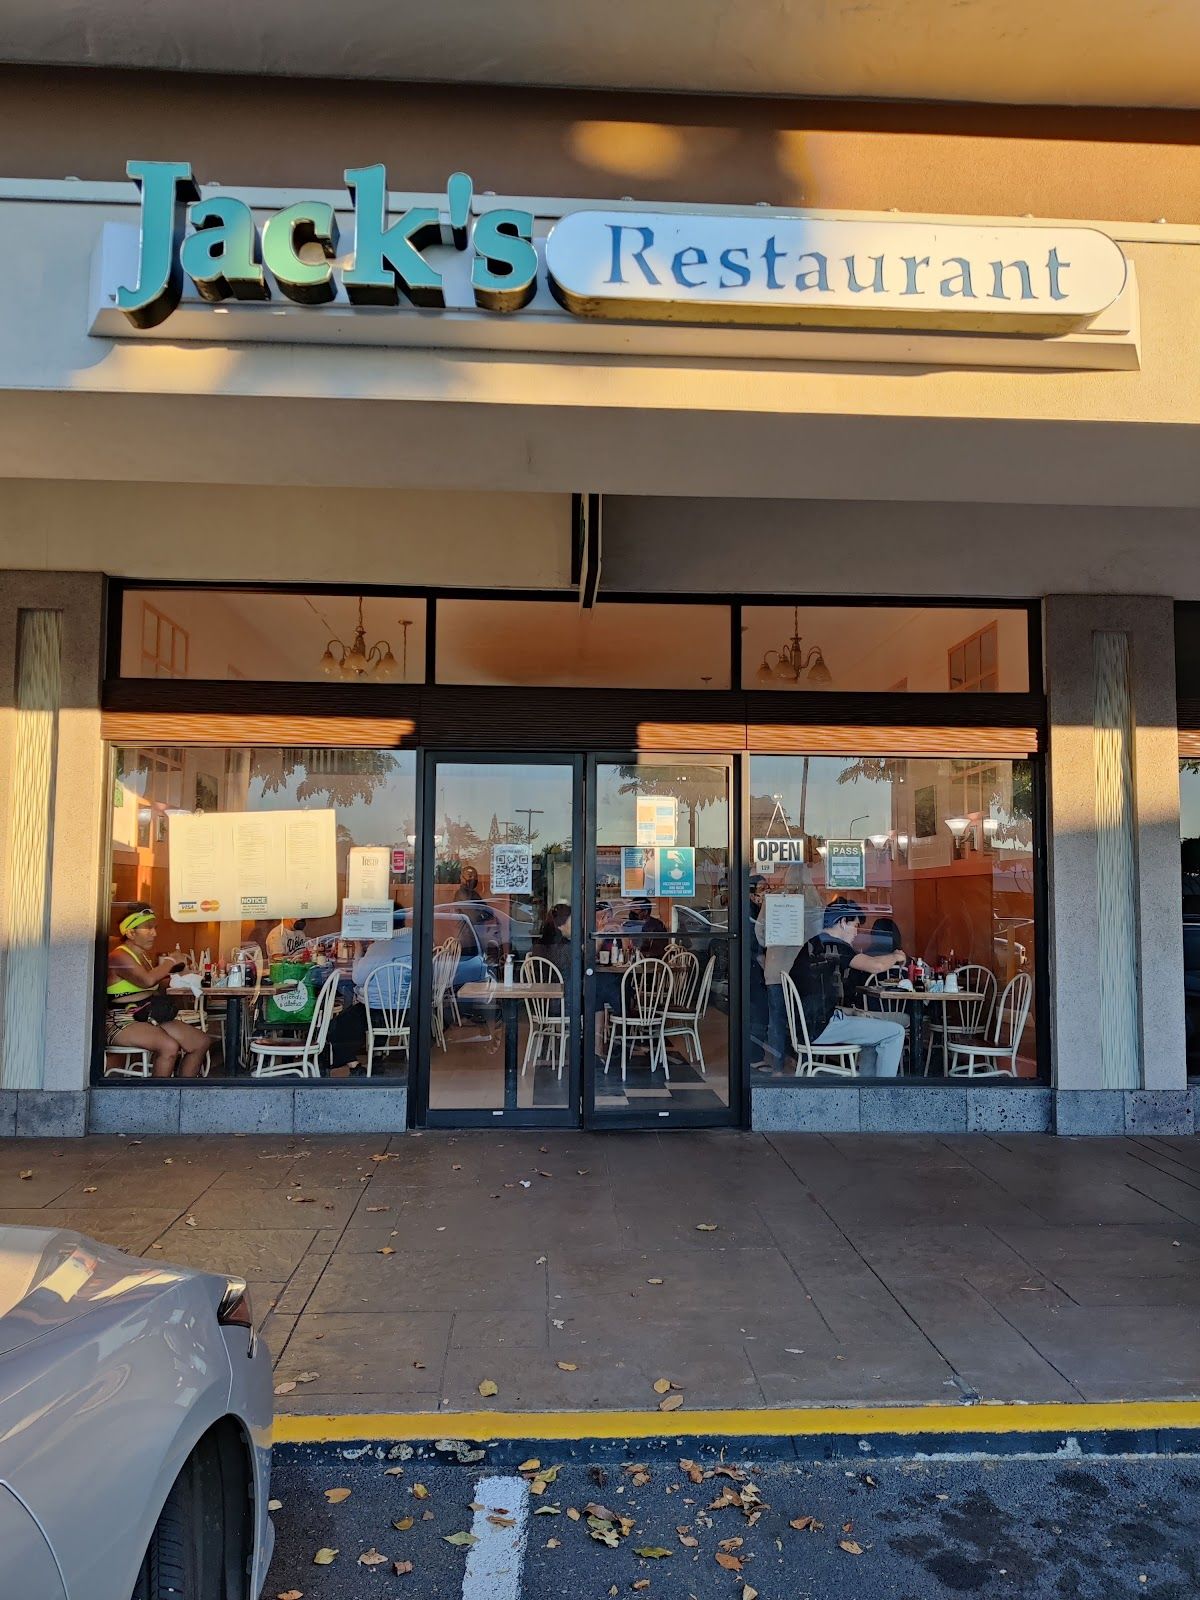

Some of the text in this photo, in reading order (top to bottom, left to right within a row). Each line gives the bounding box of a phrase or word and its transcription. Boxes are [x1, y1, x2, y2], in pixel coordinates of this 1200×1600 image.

[116, 160, 1071, 313] Jack's Restaurant
[757, 841, 801, 862] OPEN
[833, 847, 859, 855] PASS
